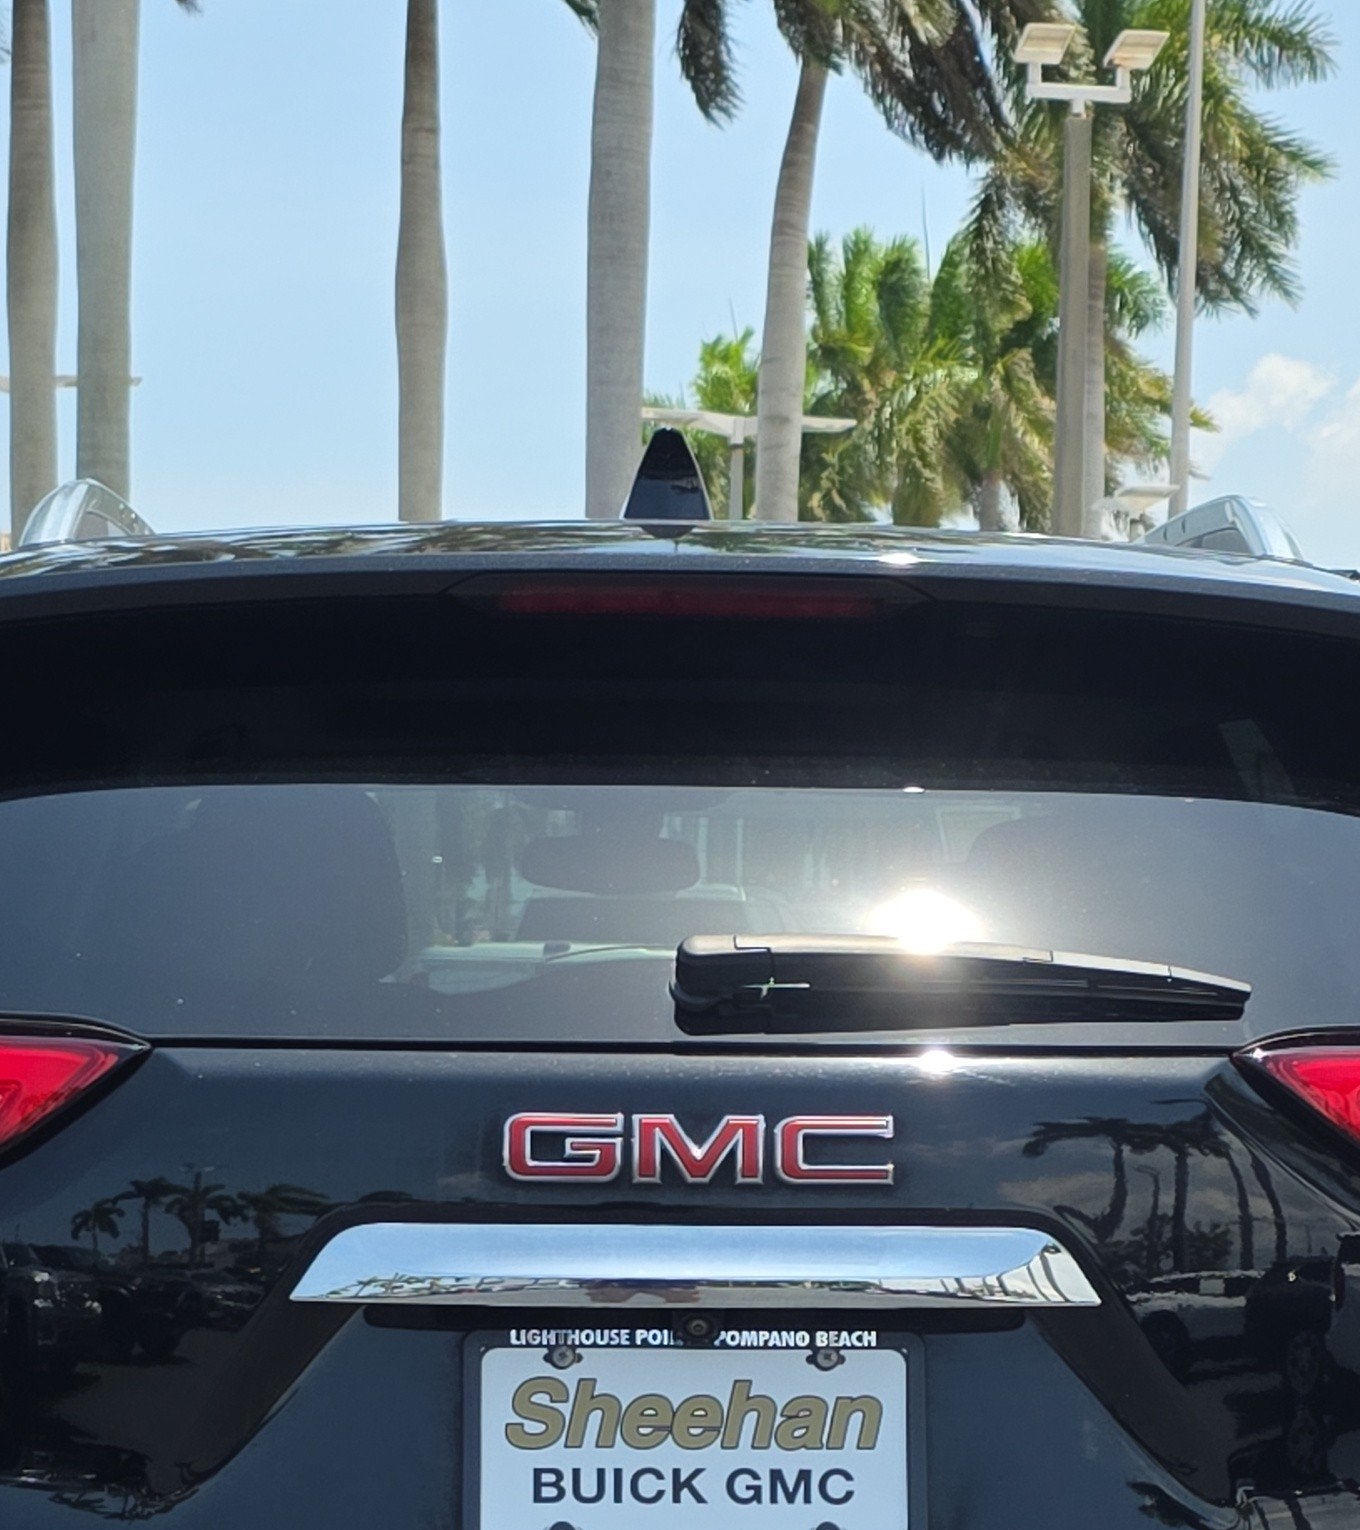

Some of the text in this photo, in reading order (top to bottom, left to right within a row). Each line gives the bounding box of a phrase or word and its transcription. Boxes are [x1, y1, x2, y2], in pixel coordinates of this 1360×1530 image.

[502, 1112, 894, 1185] GMC
[510, 1329, 630, 1345] LIGHTHOUSE
[635, 1329, 683, 1346] POI
[815, 1331, 877, 1347] BEACH
[505, 1376, 883, 1451] Sheehan
[532, 1468, 855, 1505] BUICK GMC
